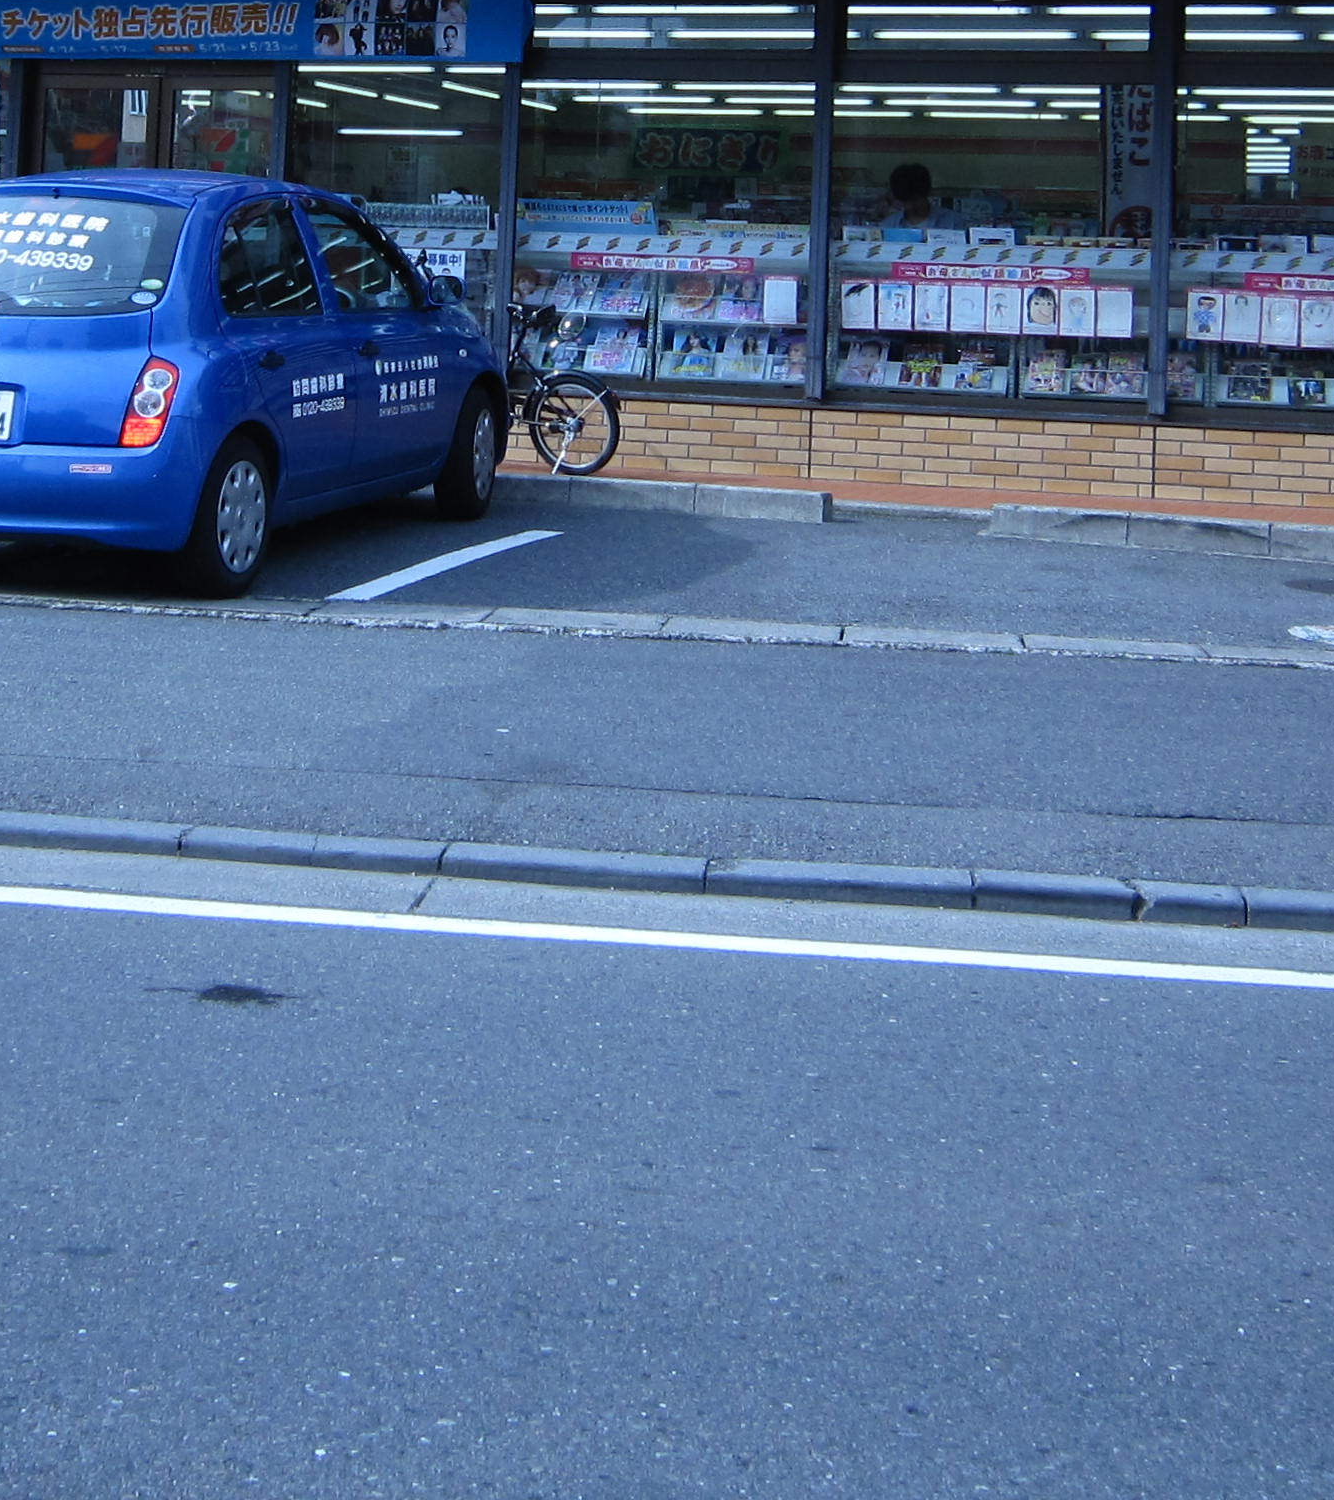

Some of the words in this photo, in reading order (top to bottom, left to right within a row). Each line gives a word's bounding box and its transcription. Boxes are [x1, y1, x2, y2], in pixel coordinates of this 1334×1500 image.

[1, 1, 300, 40] チケット独占先行販売!!
